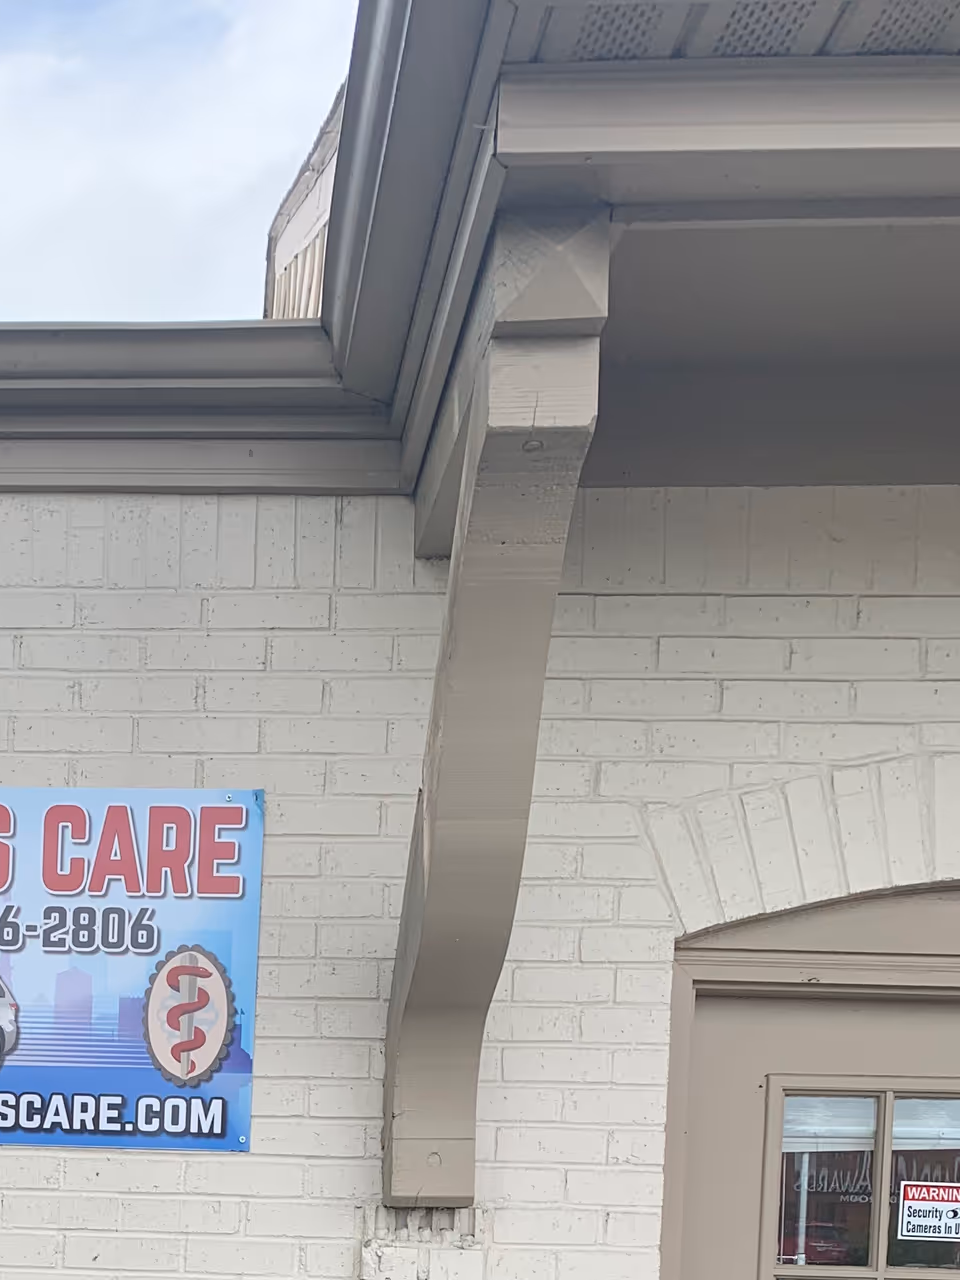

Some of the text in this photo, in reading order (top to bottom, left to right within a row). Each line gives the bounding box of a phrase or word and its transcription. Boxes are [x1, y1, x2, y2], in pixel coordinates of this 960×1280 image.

[41, 803, 248, 897] CARE
[907, 1206, 943, 1221] Security
[906, 1221, 941, 1234] Cameras
[944, 1222, 952, 1235] In
